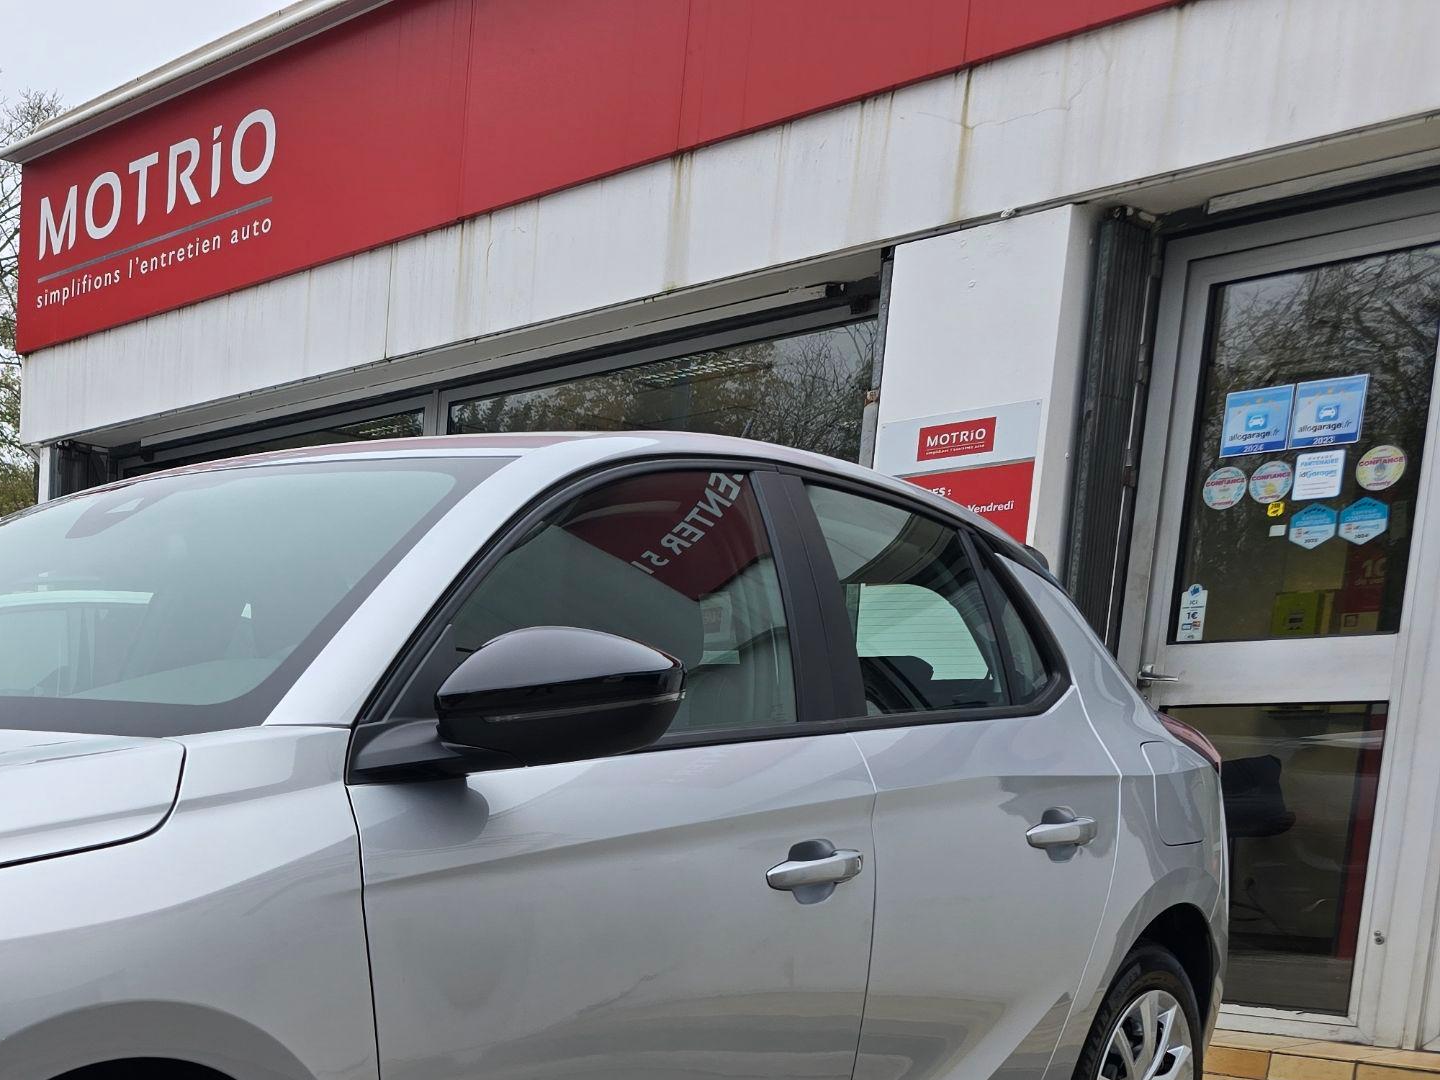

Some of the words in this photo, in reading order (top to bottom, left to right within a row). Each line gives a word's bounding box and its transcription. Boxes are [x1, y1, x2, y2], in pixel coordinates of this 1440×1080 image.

[36, 268, 120, 308] simplifions
[128, 234, 221, 278] l'entretien
[230, 217, 272, 243] auto
[1359, 456, 1405, 467] CONFIANCE
[967, 500, 1015, 513] Vendredi
